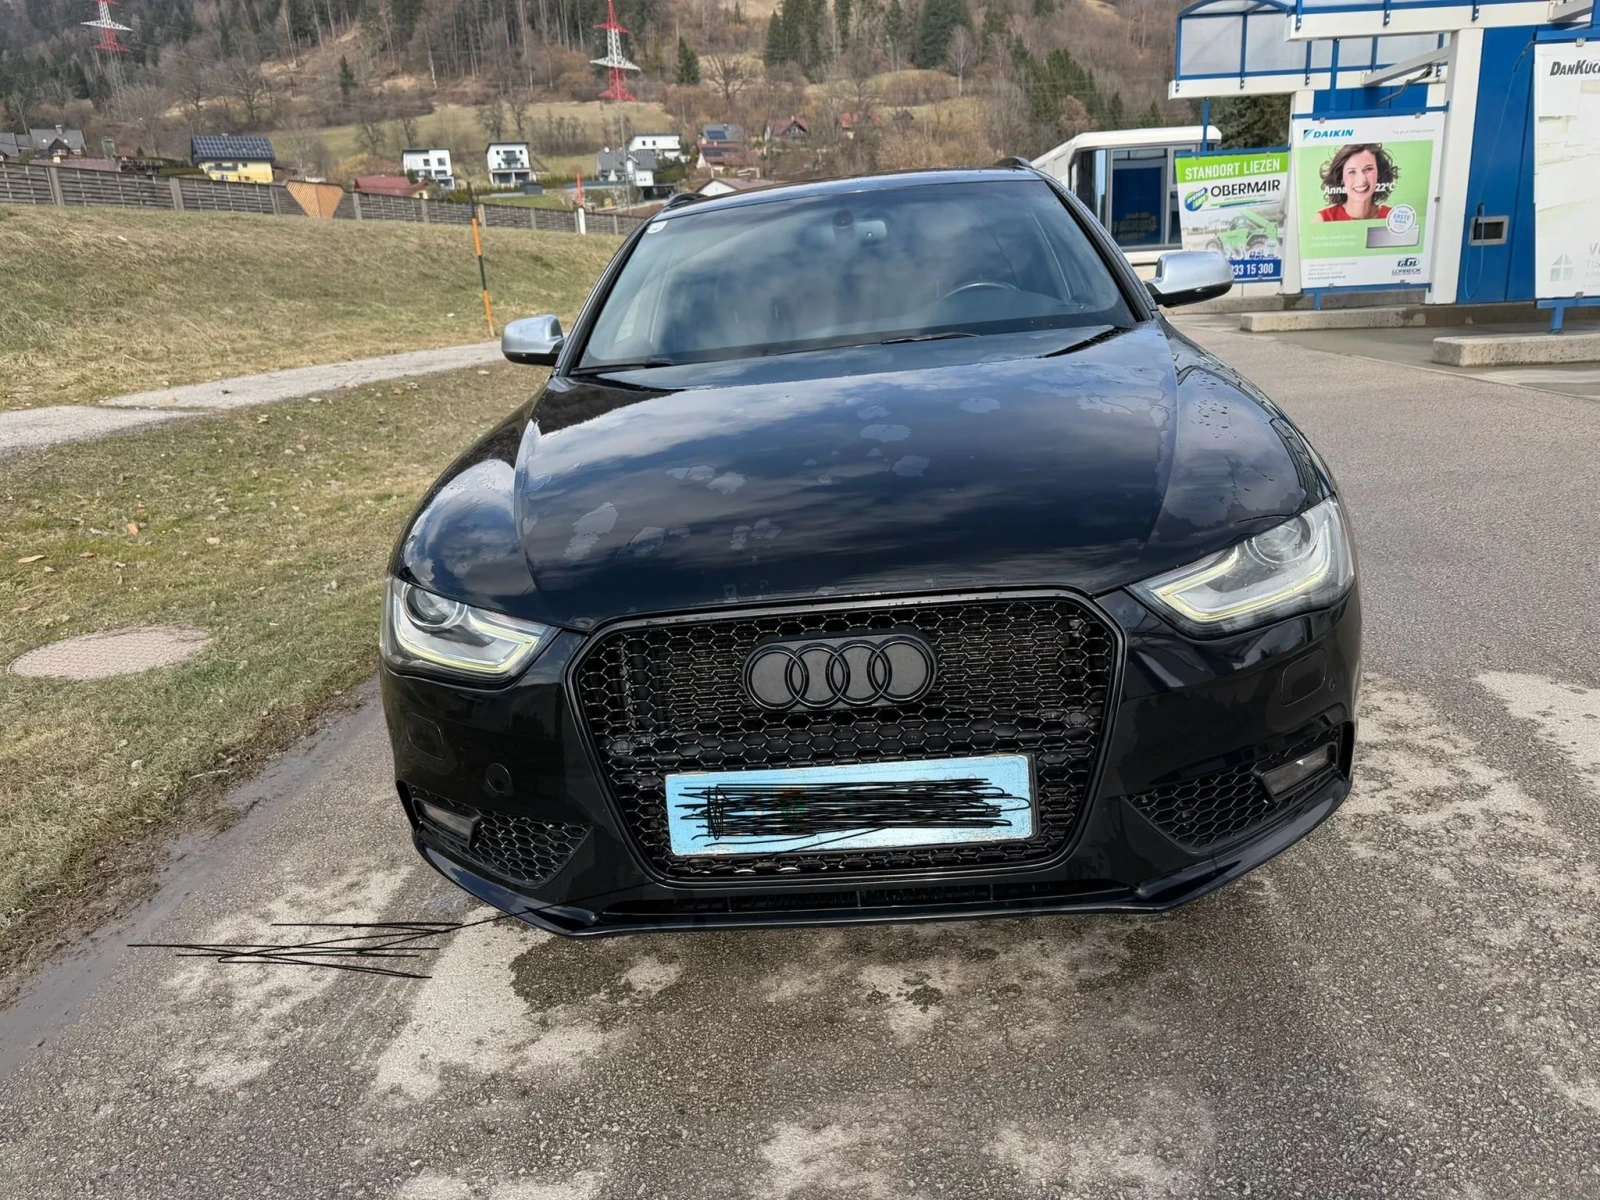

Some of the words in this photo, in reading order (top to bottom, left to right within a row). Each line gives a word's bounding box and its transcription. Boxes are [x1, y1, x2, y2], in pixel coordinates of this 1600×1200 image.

[1313, 129, 1354, 139] DAIKIN
[1185, 162, 1241, 181] STANDORT
[1244, 158, 1280, 174] LIEZEN
[1210, 179, 1281, 198] OBERMAIR
[1324, 185, 1348, 194] Anna
[1246, 263, 1257, 275] 15
[1258, 262, 1274, 274] 300
